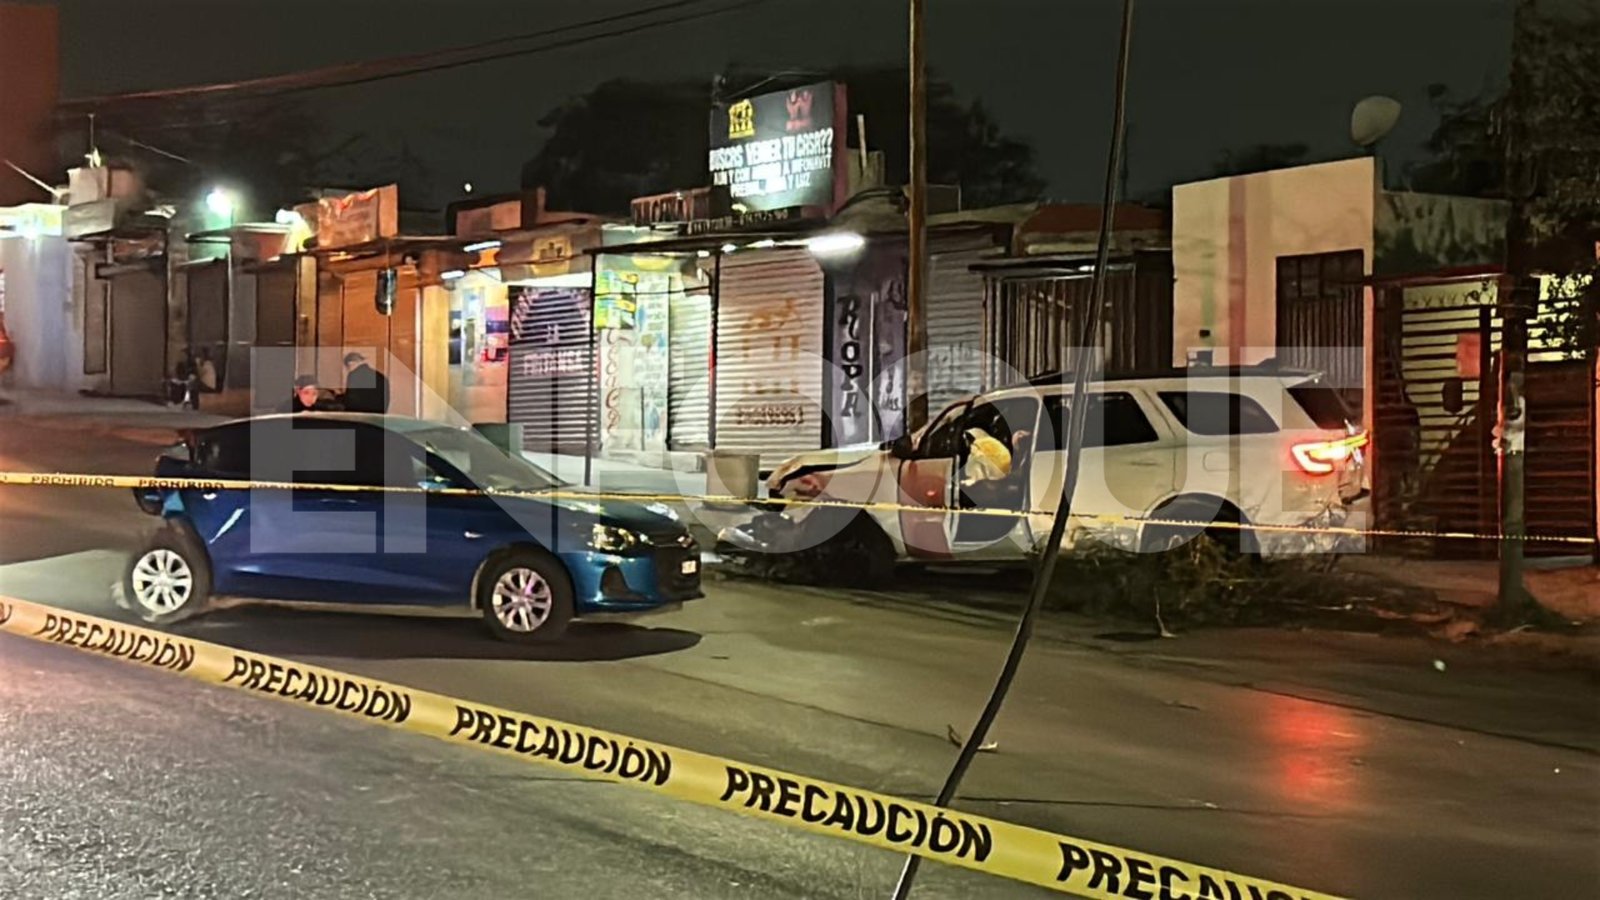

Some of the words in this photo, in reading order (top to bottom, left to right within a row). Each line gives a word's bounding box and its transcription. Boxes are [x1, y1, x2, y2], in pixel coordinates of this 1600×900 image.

[838, 296, 863, 418] ROPA
[31, 475, 115, 487] PROHIBIDO
[138, 478, 225, 489] PROHIBIDO
[34, 613, 195, 672] PRECAUCIÓN
[222, 655, 412, 723] PRECAUCIÓN
[449, 706, 672, 786] PRECAUCIÓN
[719, 766, 992, 863] PRECAUCIÓN
